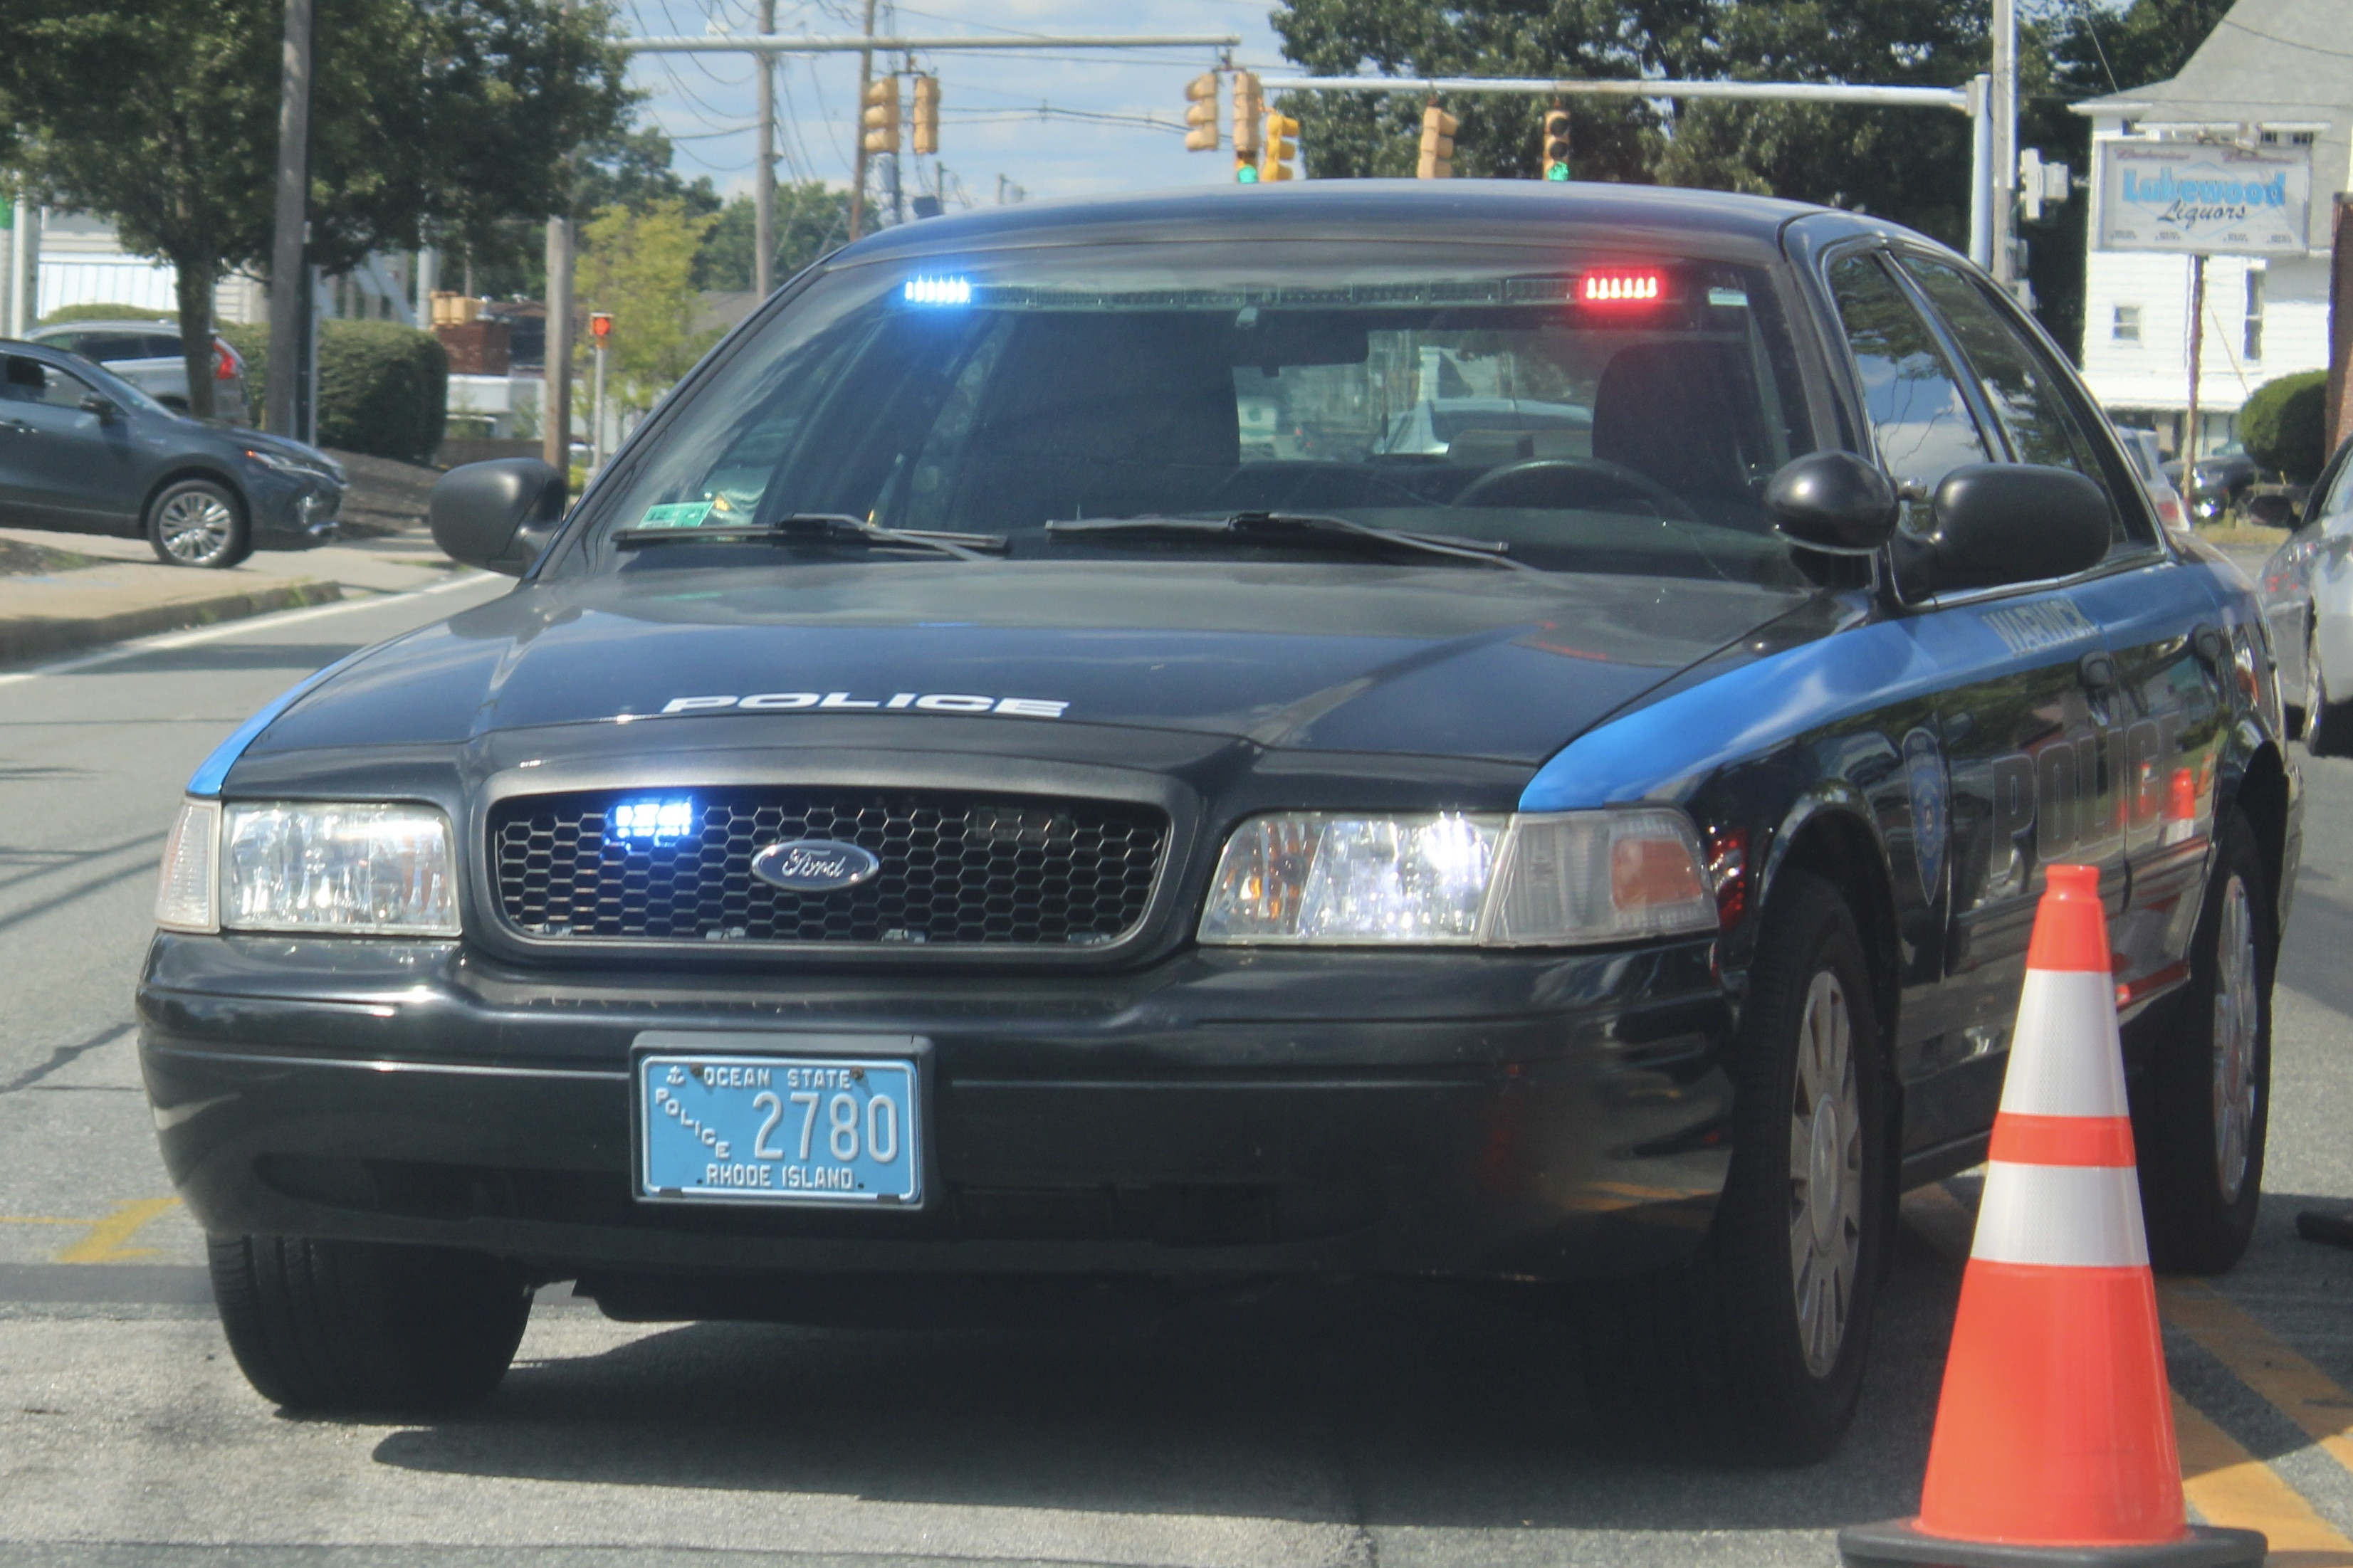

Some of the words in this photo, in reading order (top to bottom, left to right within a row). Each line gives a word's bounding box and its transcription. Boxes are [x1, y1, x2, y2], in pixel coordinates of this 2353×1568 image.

[2123, 167, 2286, 207] Lakewood
[2157, 199, 2246, 229] Liquors
[662, 692, 1069, 717] POLICE
[1990, 710, 2189, 880] POLICE
[782, 848, 847, 878] Ford
[704, 1067, 770, 1088] OCEAN
[787, 1068, 852, 1089] STATE
[655, 1088, 730, 1159] POLICE
[753, 1090, 898, 1164] 2780
[706, 1164, 772, 1187] RHODE
[783, 1165, 854, 1189] ISLAND
